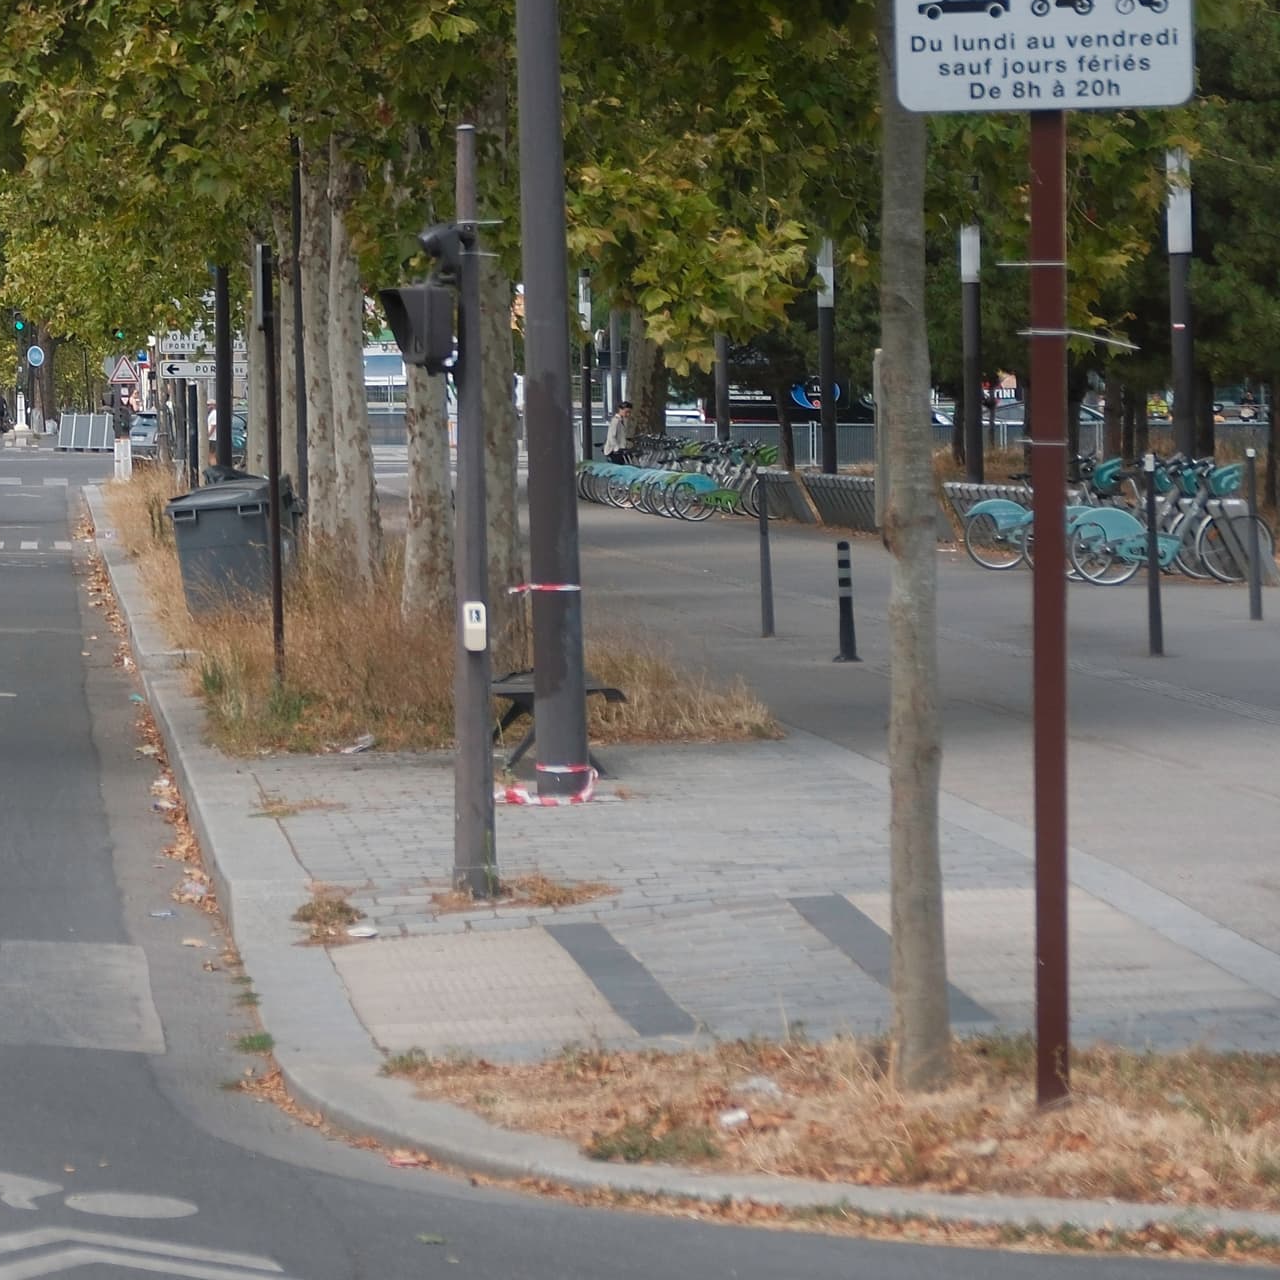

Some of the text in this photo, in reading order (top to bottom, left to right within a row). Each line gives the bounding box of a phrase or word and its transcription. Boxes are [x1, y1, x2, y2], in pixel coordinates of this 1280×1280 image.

[911, 28, 1179, 53] Du lundi au vendredi
[938, 53, 1151, 79] sauf jours fériés
[970, 79, 1121, 100] De 8h à 20h
